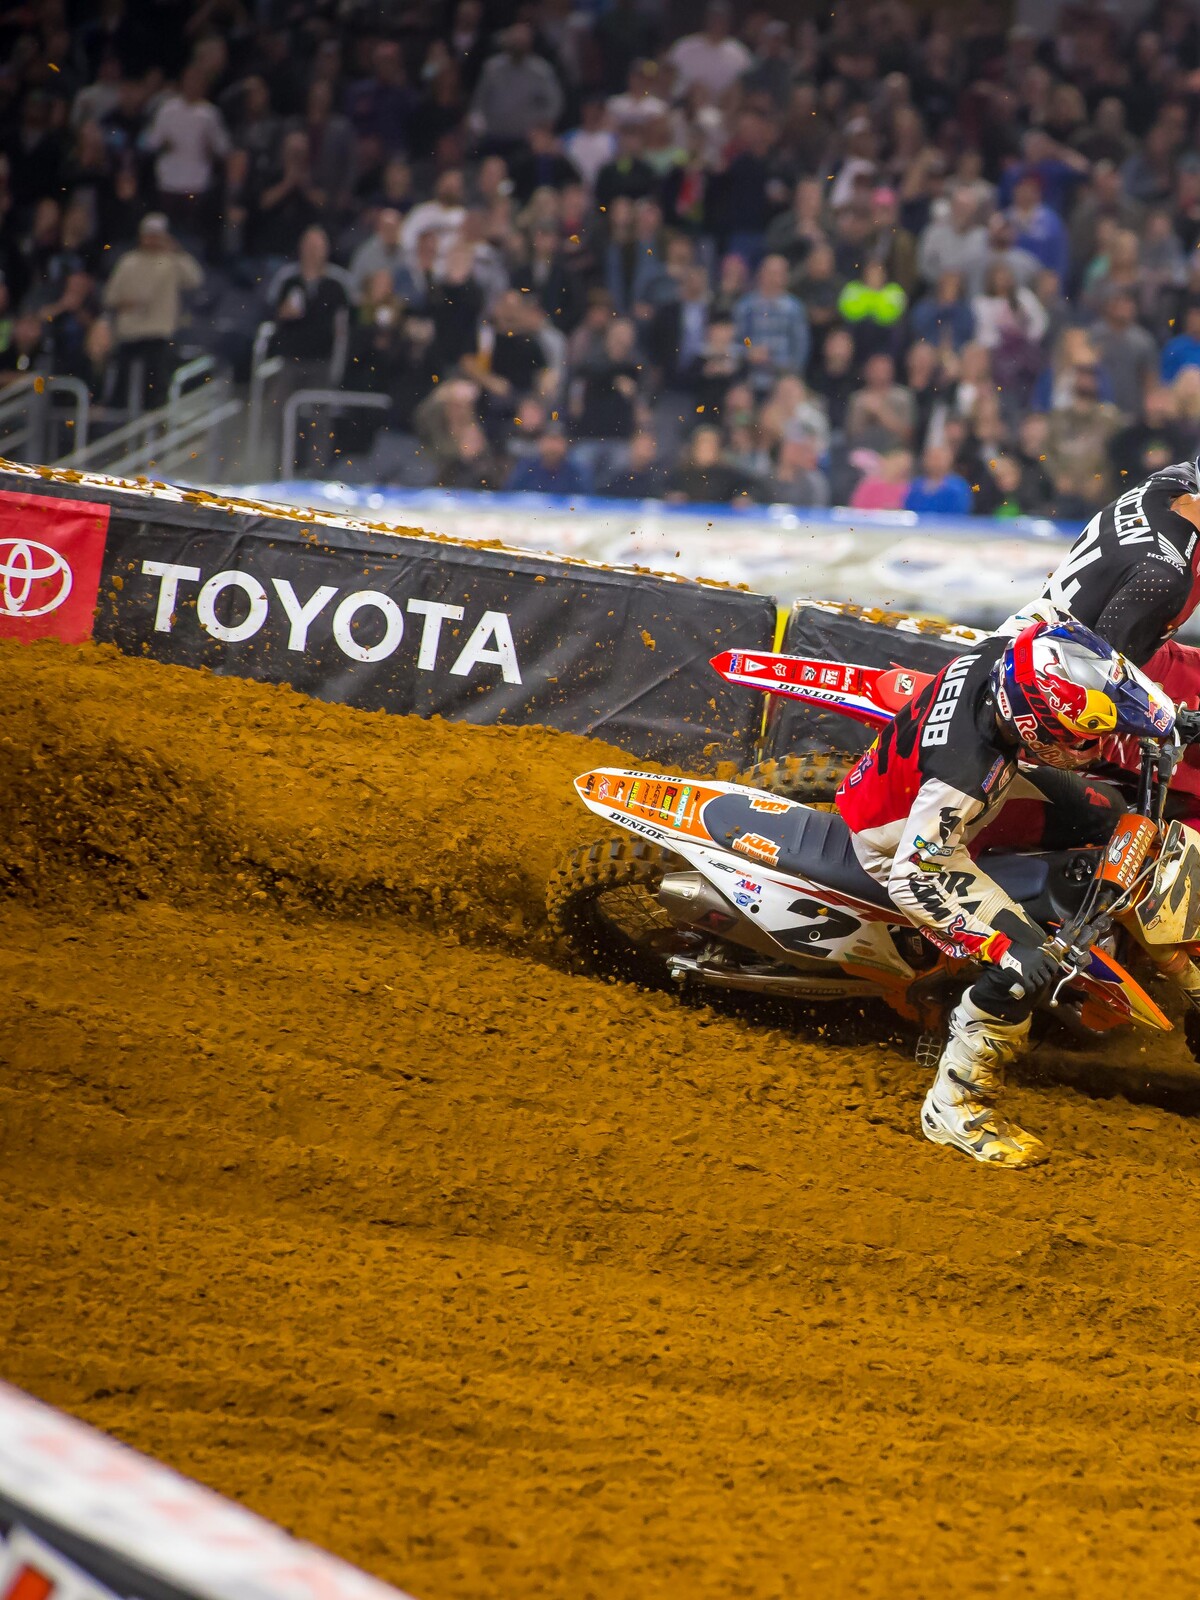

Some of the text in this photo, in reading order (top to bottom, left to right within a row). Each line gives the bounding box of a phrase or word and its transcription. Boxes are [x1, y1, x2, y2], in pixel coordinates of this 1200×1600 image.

[1146, 551, 1184, 575] HONDA
[141, 560, 524, 686] TOYOTA
[777, 683, 846, 703] DUNLOP
[921, 654, 982, 748] WEBB
[999, 691, 1011, 718] BELL
[623, 770, 683, 783] DUNLOP
[752, 798, 790, 813] KTM
[608, 812, 665, 840] DUNLOP
[741, 834, 779, 855] KTM
[1116, 823, 1149, 882] RENTHAL
[736, 879, 763, 894] AMA
[767, 898, 862, 959] 2
